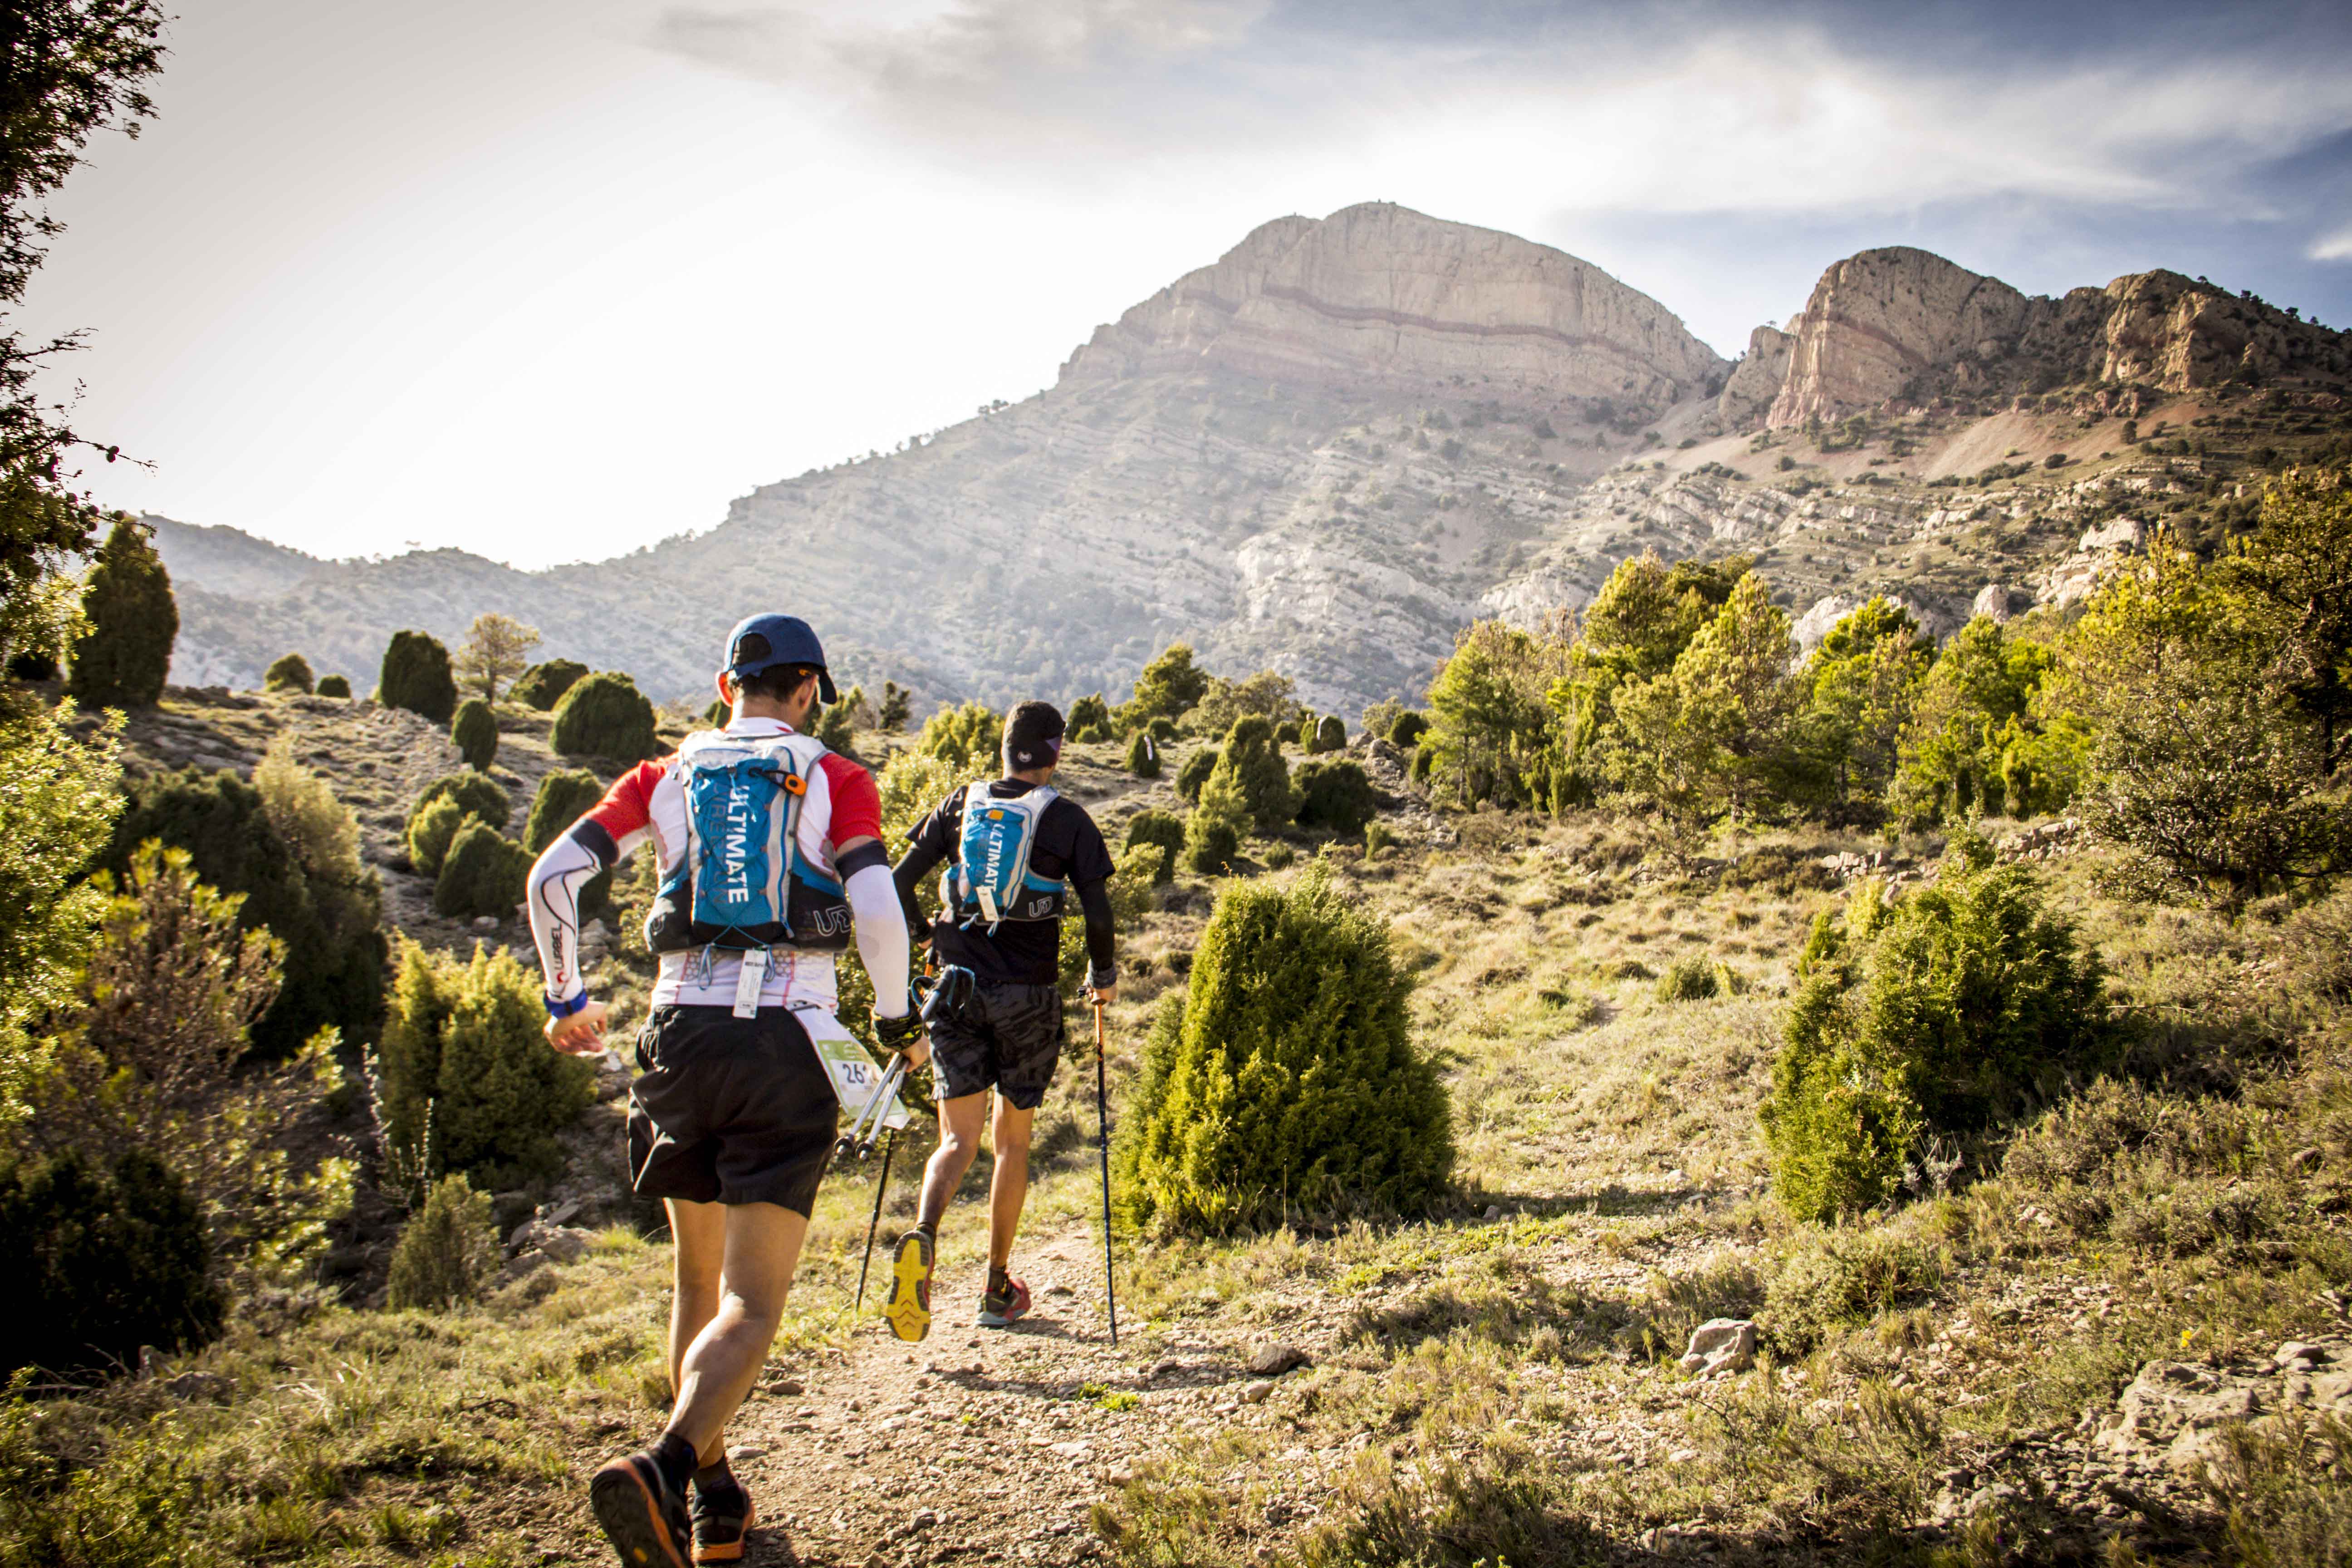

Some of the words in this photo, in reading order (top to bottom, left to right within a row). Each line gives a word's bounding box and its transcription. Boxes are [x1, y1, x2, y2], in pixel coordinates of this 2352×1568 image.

[710, 782, 729, 904] DIRECTON
[726, 785, 750, 903] ULTIMATE
[842, 1063, 867, 1084] 26
